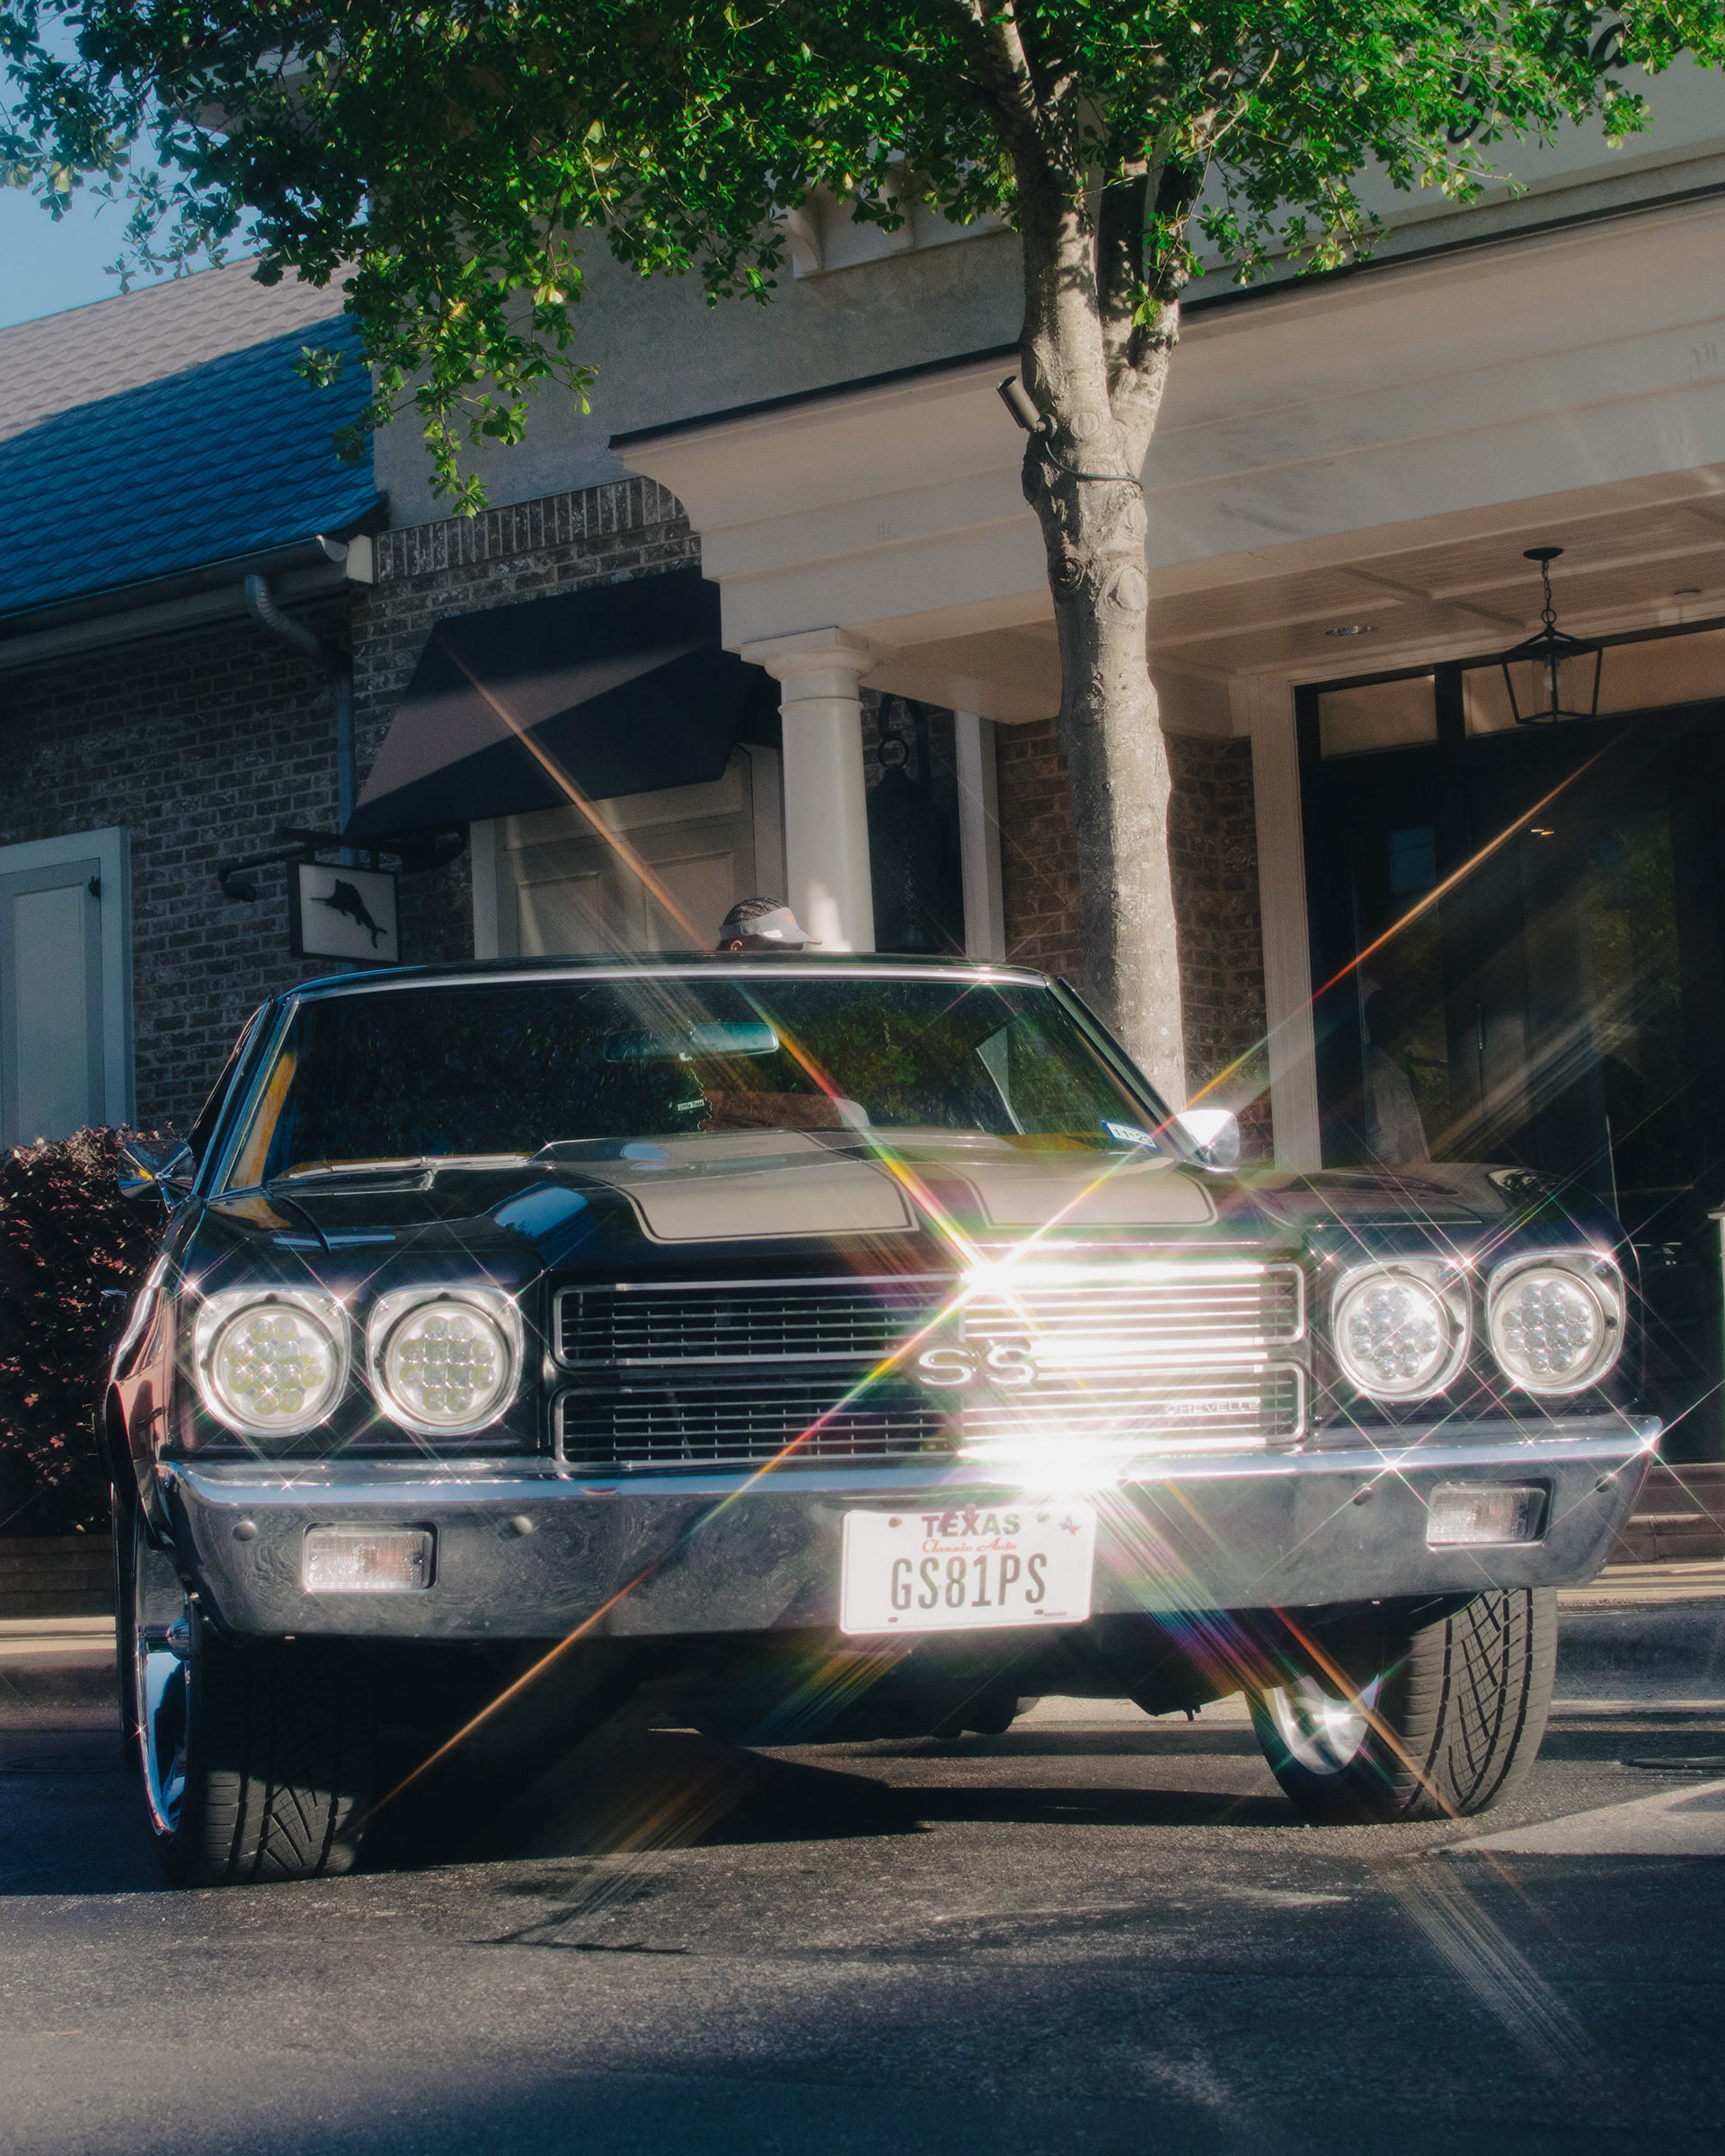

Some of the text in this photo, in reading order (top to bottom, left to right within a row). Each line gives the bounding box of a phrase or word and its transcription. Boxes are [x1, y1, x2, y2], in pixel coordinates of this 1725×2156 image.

[917, 1343, 1035, 1385] SS
[1165, 1401, 1261, 1415] CHEVELLE
[921, 1513, 1021, 1538] TEXAS
[922, 1536, 1017, 1553] Classic Auto
[891, 1552, 1048, 1611] GS81PS
